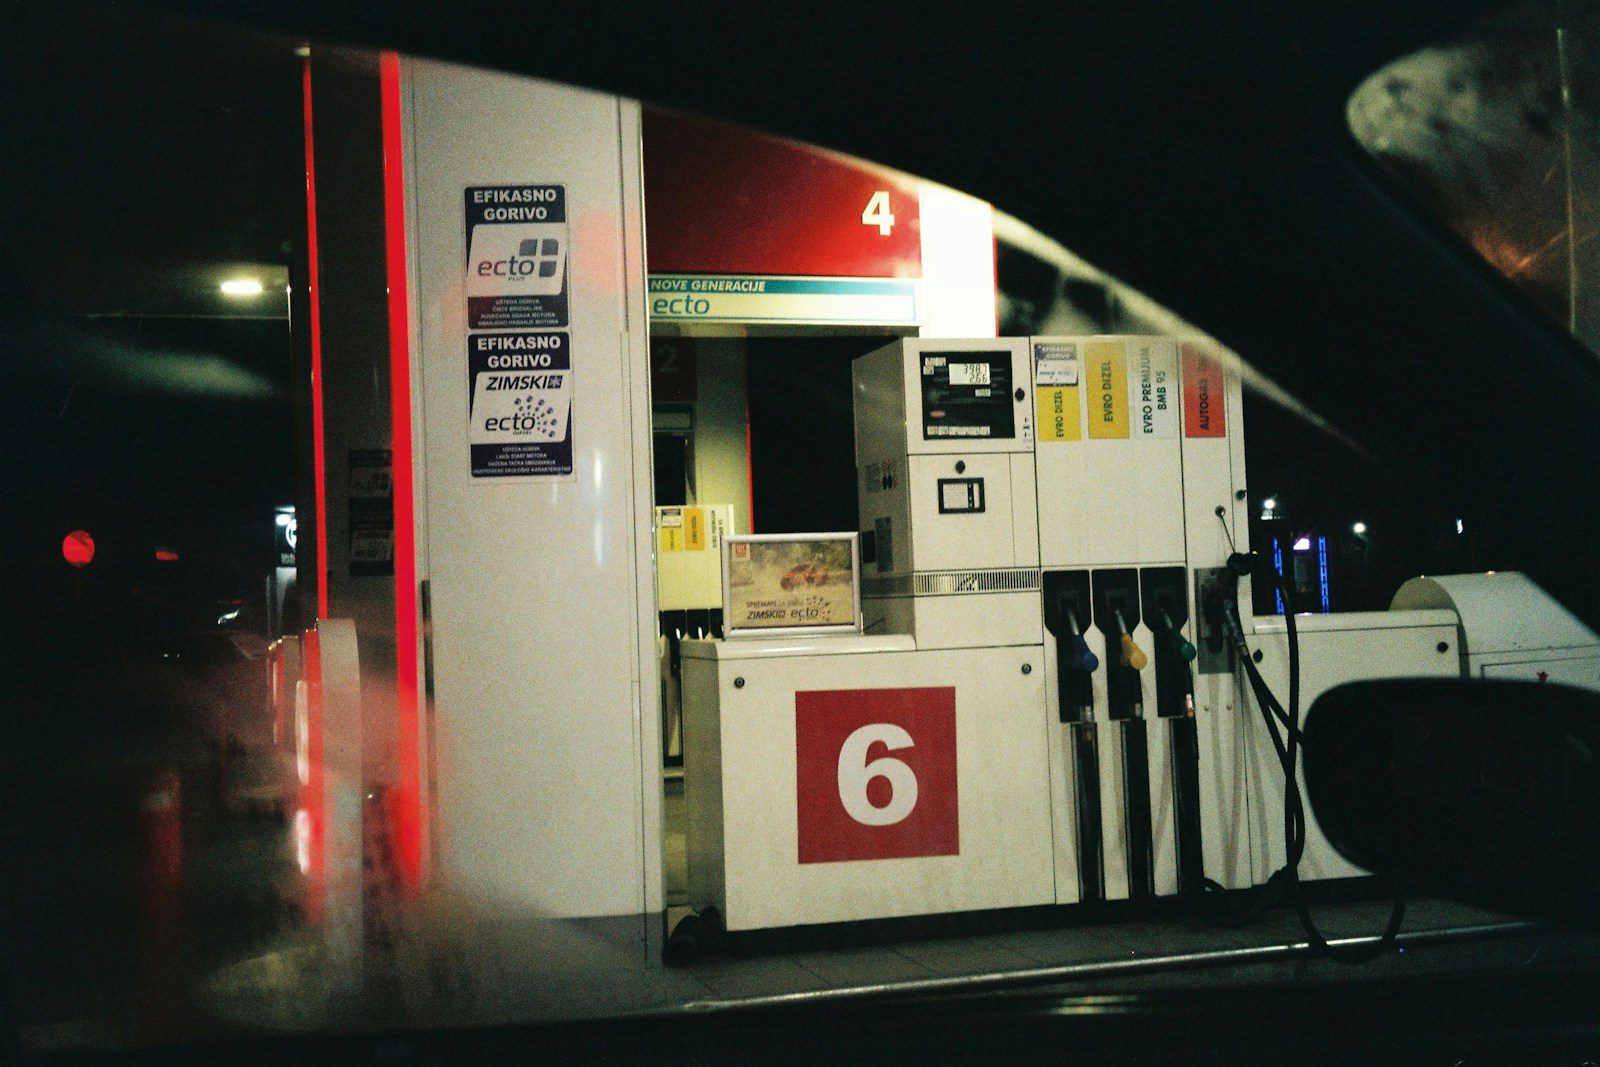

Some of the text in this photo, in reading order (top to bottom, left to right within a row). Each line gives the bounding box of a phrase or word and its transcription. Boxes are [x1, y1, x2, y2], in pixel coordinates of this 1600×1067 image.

[473, 189, 557, 204] EFIKASNO
[483, 206, 548, 221] GORIVO
[862, 191, 895, 236] 4
[477, 256, 535, 277] ecto
[650, 280, 766, 293] NOVE GENERACIJE
[653, 295, 710, 315] ecto
[477, 336, 561, 351] EFIKASNO
[487, 353, 552, 368] GORIVO
[486, 375, 548, 391] ZIMSKI
[1101, 360, 1114, 422] EVRO DIZEL
[1156, 370, 1167, 411] BMB 95
[485, 413, 536, 431] ecto
[1053, 390, 1065, 438] EVRO DIZEL
[1142, 405, 1153, 434] EVRO
[790, 607, 819, 619] ecto
[837, 722, 919, 827] 6
